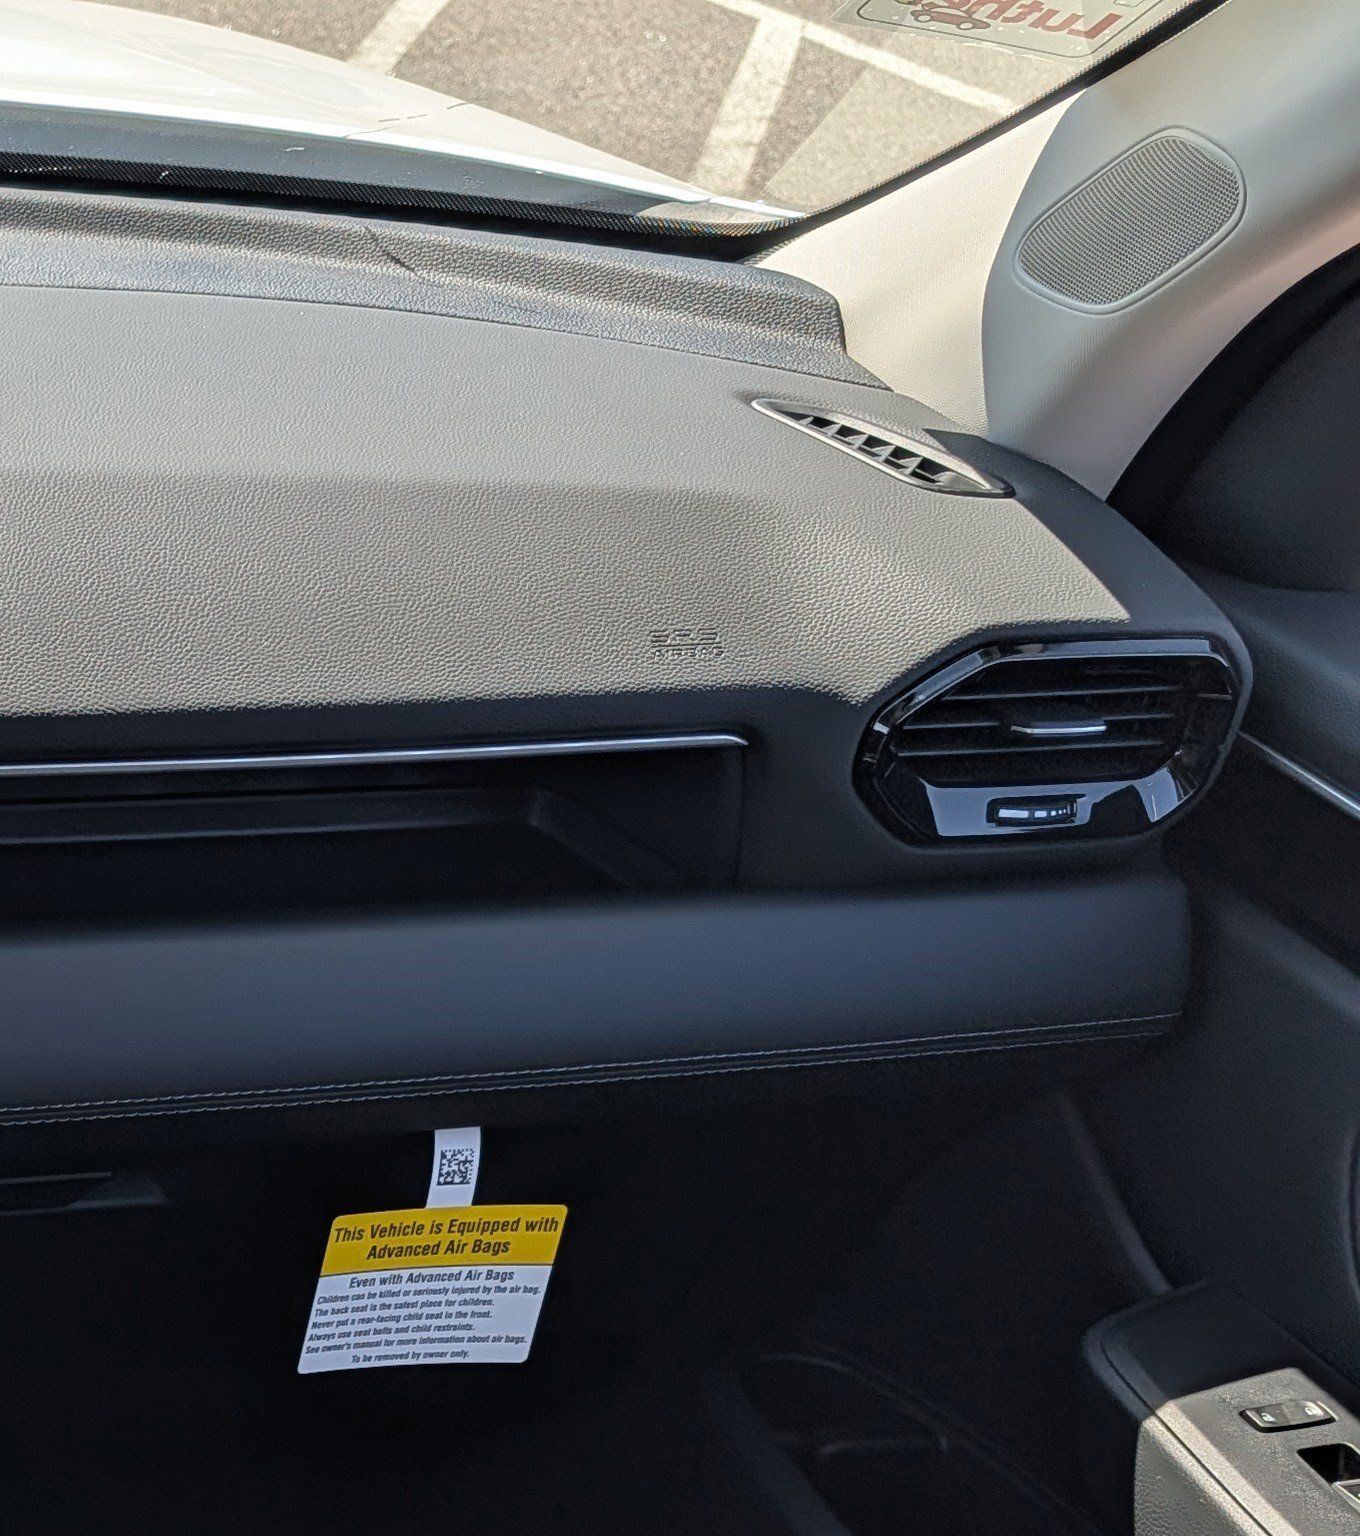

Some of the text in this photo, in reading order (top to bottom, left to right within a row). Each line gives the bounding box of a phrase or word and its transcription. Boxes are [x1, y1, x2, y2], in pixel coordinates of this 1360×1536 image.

[334, 1217, 559, 1244] This Vehicle is Equipped with
[366, 1239, 511, 1260] Advanced Air Bags
[349, 1269, 515, 1289] Even with Advanced Air Bags
[315, 1308, 328, 1317] The
[331, 1306, 349, 1315] back
[351, 1304, 368, 1313] seat
[379, 1302, 391, 1311] the
[394, 1300, 419, 1310] safest
[421, 1300, 442, 1309] place
[445, 1299, 456, 1307] for
[336, 1319, 348, 1328] put
[402, 1313, 424, 1321] child
[425, 1312, 443, 1320] seat
[445, 1311, 453, 1319] in
[455, 1310, 468, 1319] the
[351, 1355, 360, 1364] To
[363, 1354, 373, 1362] be
[374, 1352, 409, 1361] removed
[411, 1351, 421, 1360] by
[423, 1350, 449, 1358] owner
